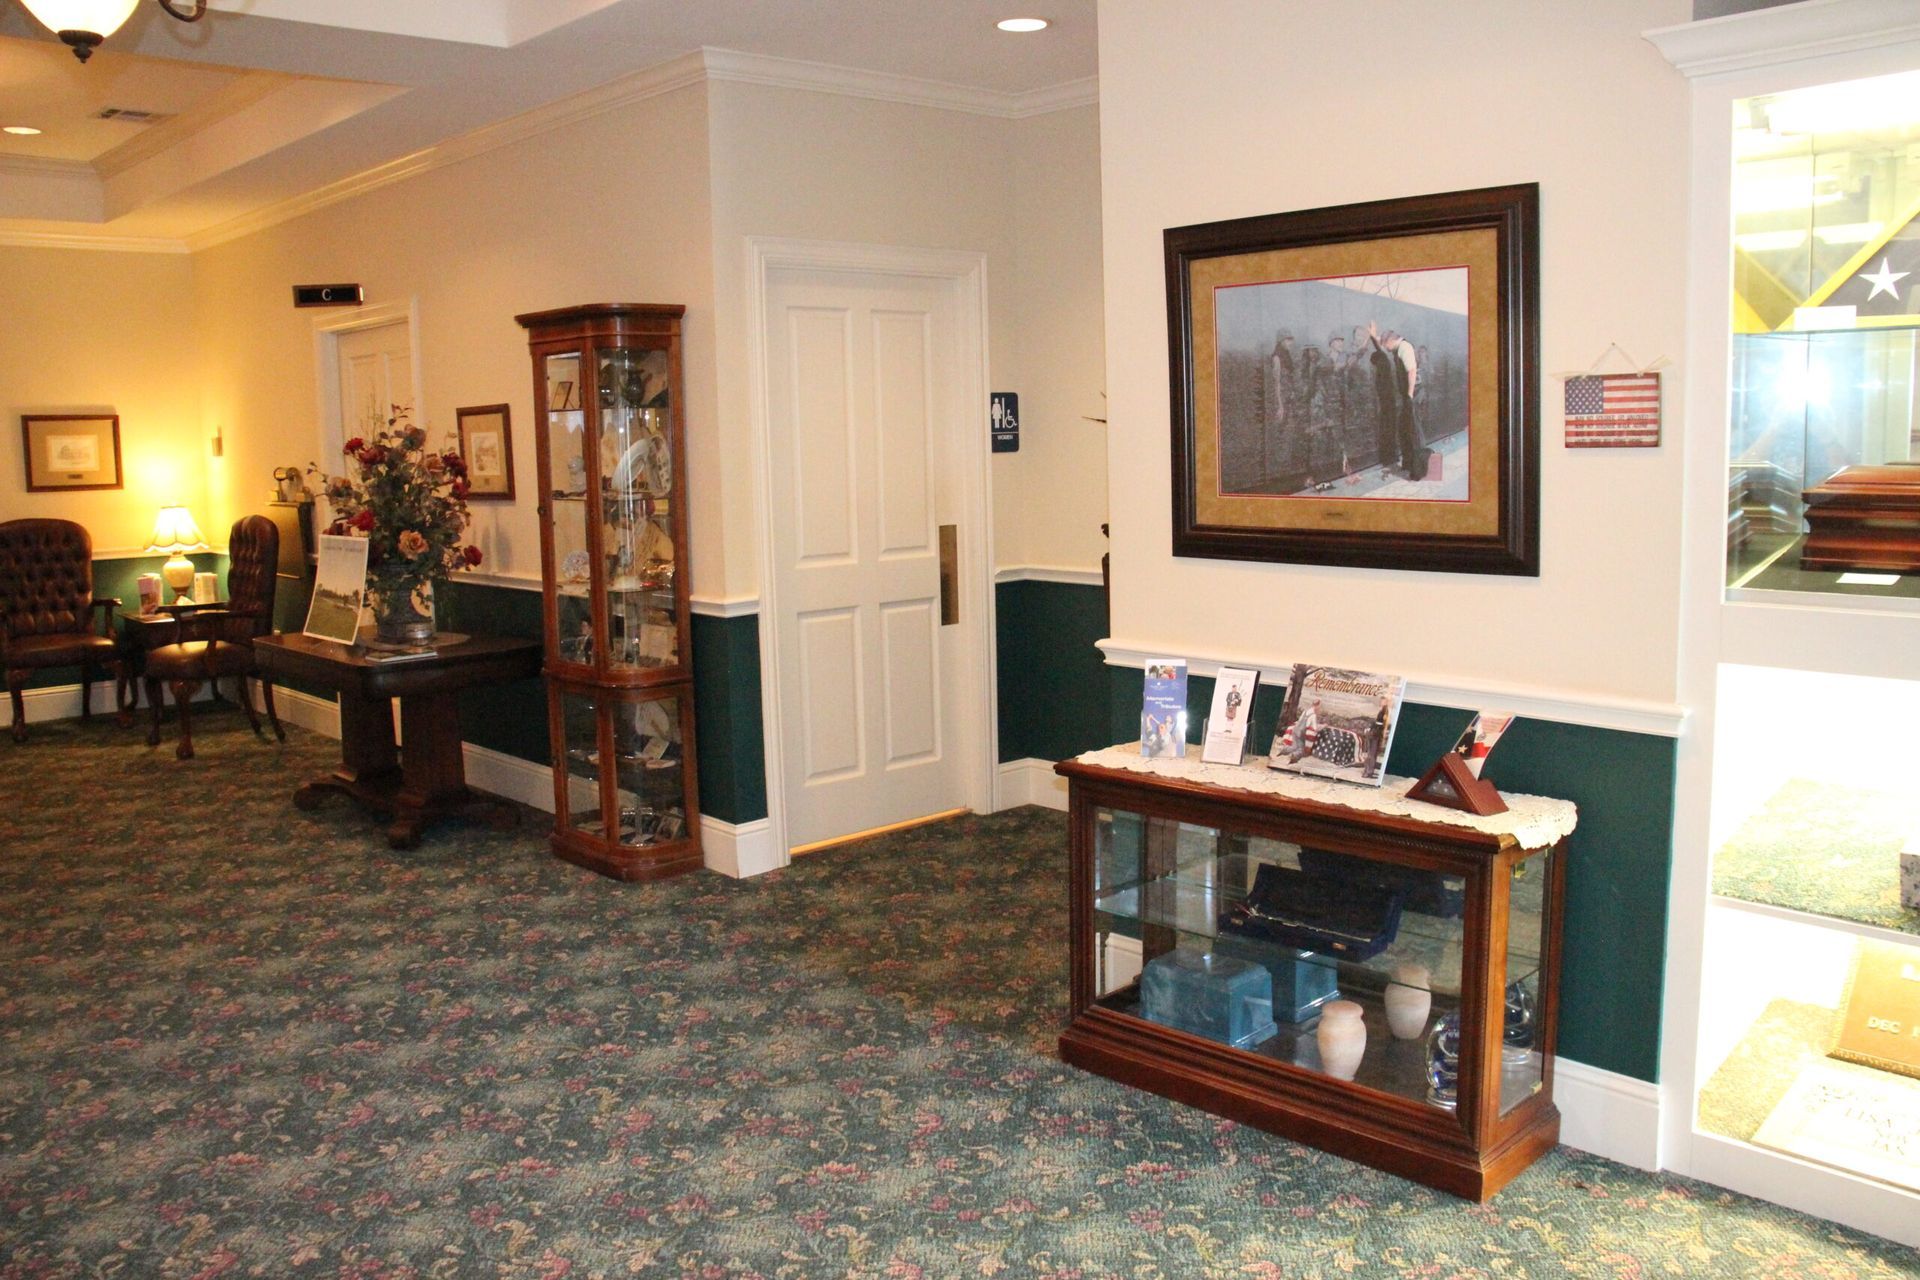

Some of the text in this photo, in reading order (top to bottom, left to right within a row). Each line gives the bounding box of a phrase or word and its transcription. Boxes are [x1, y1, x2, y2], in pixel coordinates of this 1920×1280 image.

[322, 288, 332, 301] C
[1305, 671, 1384, 697] Remembrance
[1867, 1016, 1901, 1034] DEC
